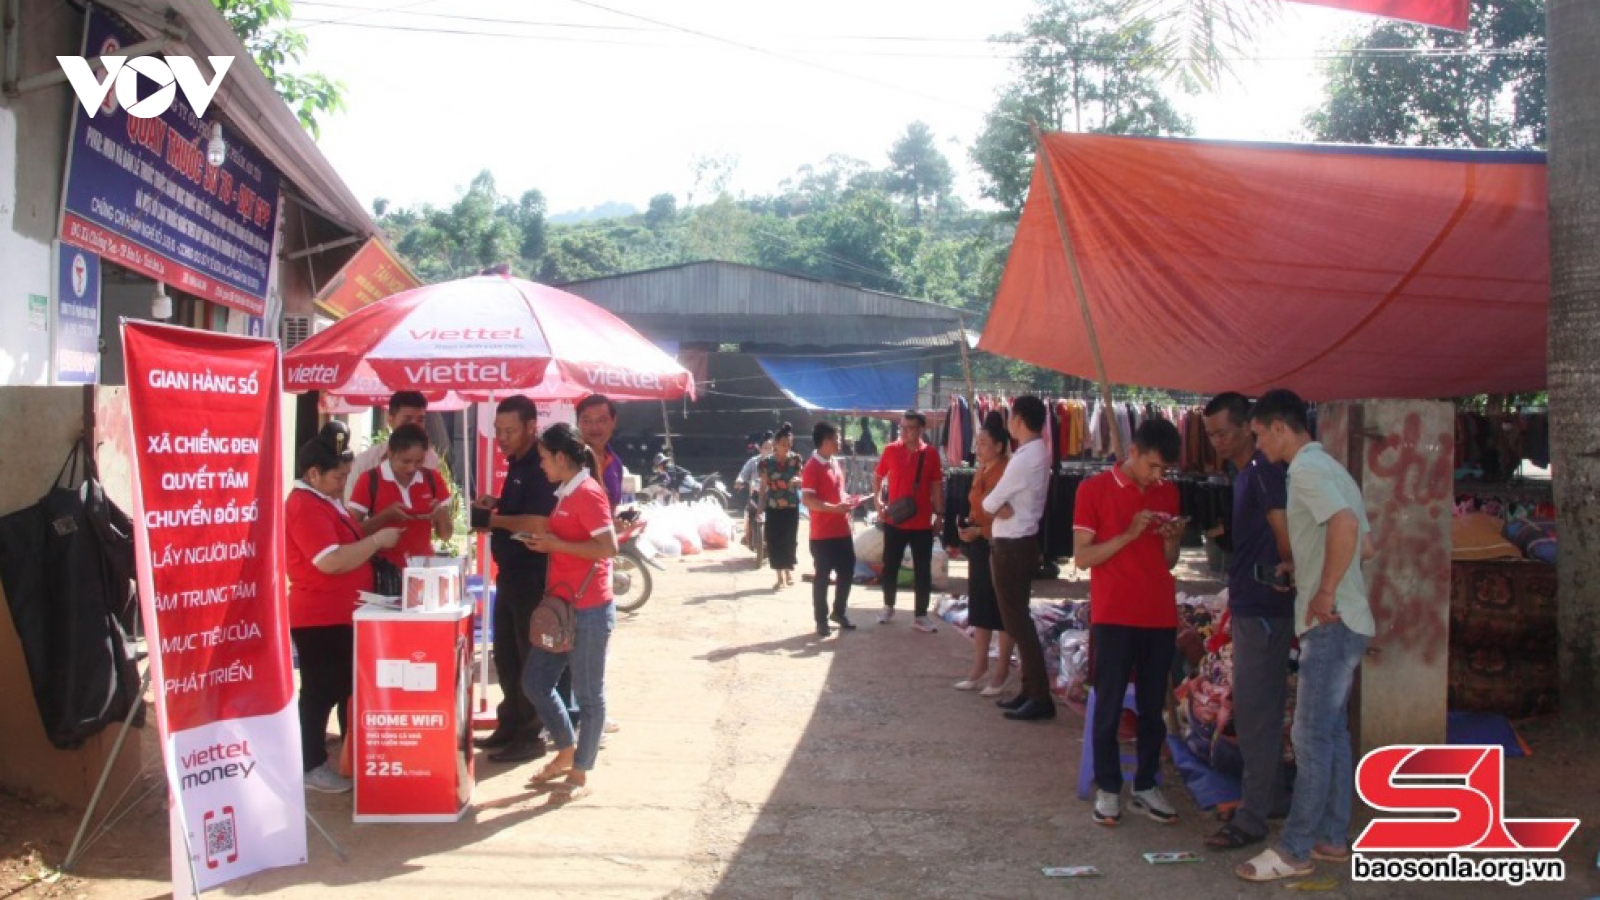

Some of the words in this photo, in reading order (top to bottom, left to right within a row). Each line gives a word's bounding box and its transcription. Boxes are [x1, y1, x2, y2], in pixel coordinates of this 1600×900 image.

[409, 327, 524, 340] viettel
[149, 369, 189, 389] GIAN
[193, 368, 235, 393] HÀNG
[238, 371, 258, 395] SỐ
[287, 363, 340, 384] viettel
[404, 361, 511, 384] viettel
[586, 366, 663, 391] viettel
[148, 432, 172, 454] XÃ
[174, 428, 229, 454] CHIỀNG
[231, 437, 259, 454] ĐEN
[161, 464, 215, 491] QUYẾT
[218, 467, 249, 489] TÂM
[145, 499, 212, 528] CHUYỂN
[214, 498, 239, 524] ĐỔI
[241, 498, 258, 522] SỐ
[153, 543, 182, 568] LẤY
[184, 541, 227, 564] NGƯỜI
[229, 539, 256, 559] DÂN
[180, 586, 227, 608] TRUNG
[229, 582, 256, 599] TÂM
[161, 632, 196, 654] MỤC
[201, 626, 225, 647] TIÊU
[226, 620, 262, 642] CỦA
[164, 673, 205, 697] PHÁT
[207, 660, 253, 685] TRIỂN
[366, 714, 408, 726] HOME
[411, 714, 444, 726] WIFI
[181, 740, 252, 770] viettel
[181, 760, 256, 791] money
[365, 761, 403, 776] 225
